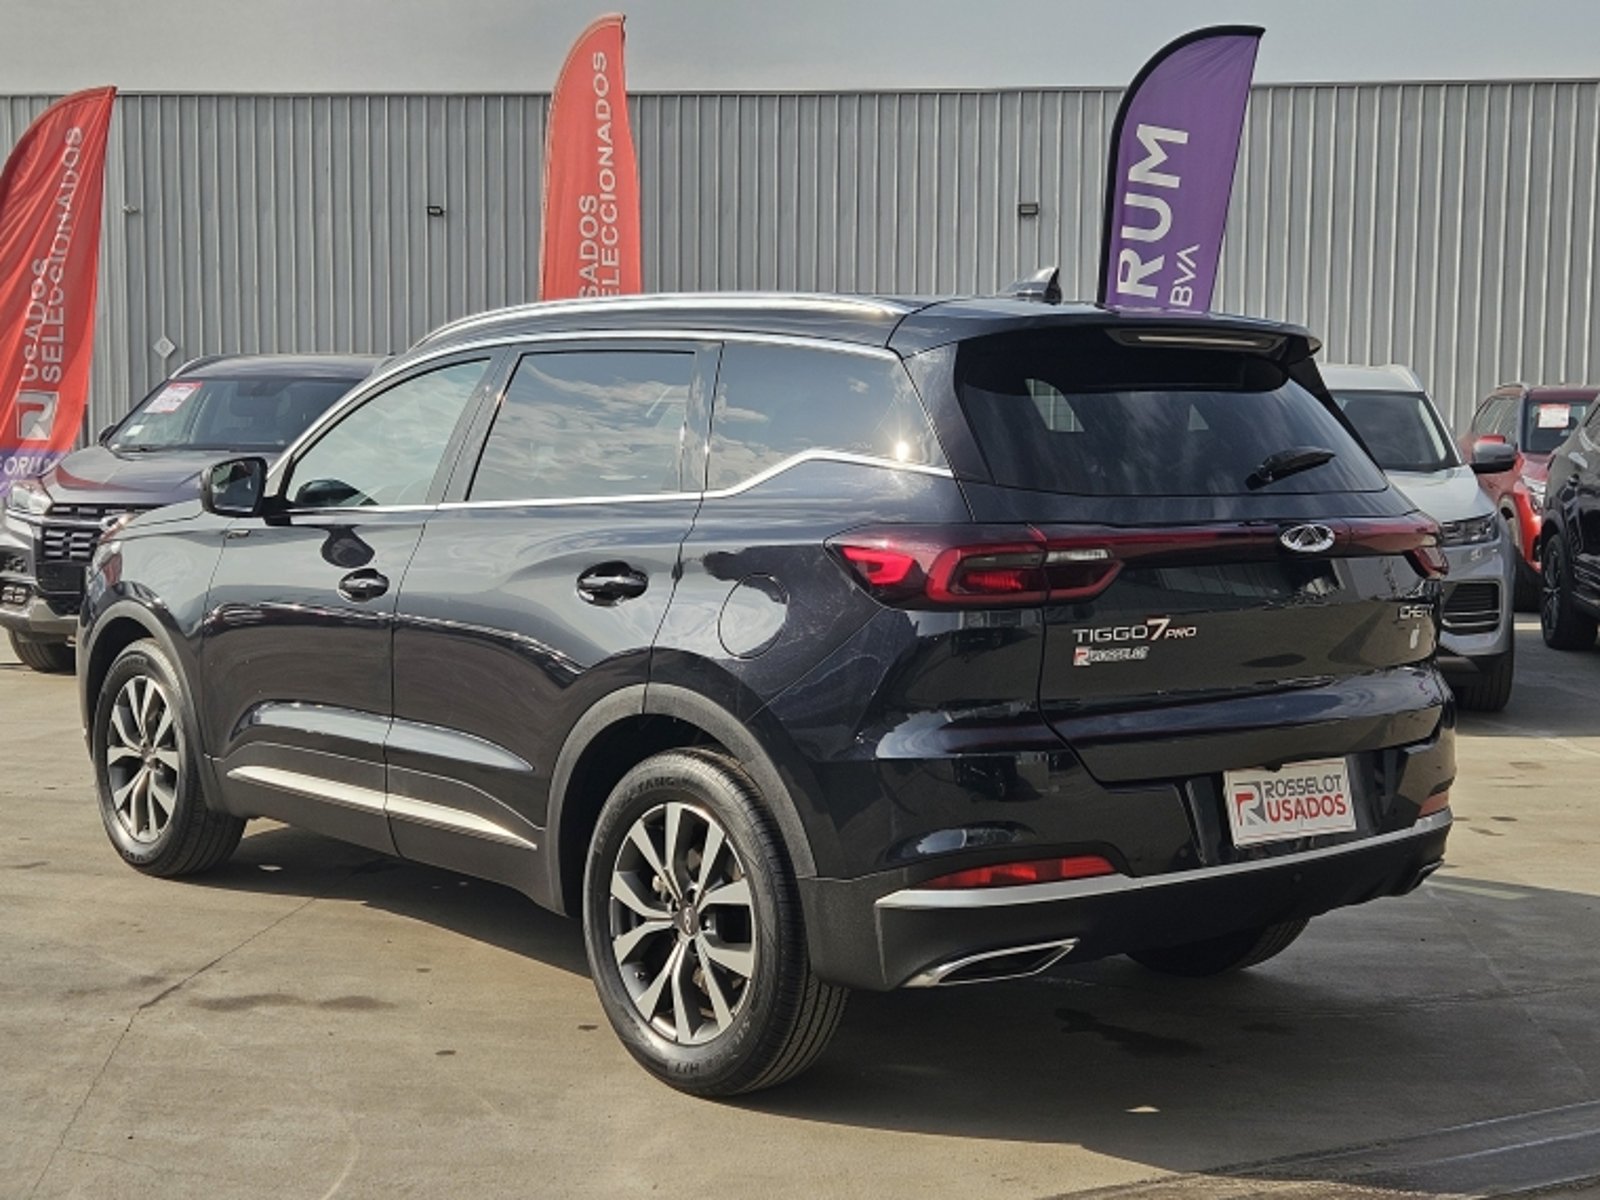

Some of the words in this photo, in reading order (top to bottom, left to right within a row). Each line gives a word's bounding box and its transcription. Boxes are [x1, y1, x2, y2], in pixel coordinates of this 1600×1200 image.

[40, 126, 83, 384] SELECCIONADOS
[1116, 123, 1189, 299] RUM
[20, 257, 48, 383] USADOS
[1263, 774, 1342, 799] ROSSELOT
[1267, 794, 1347, 822] USADOS
